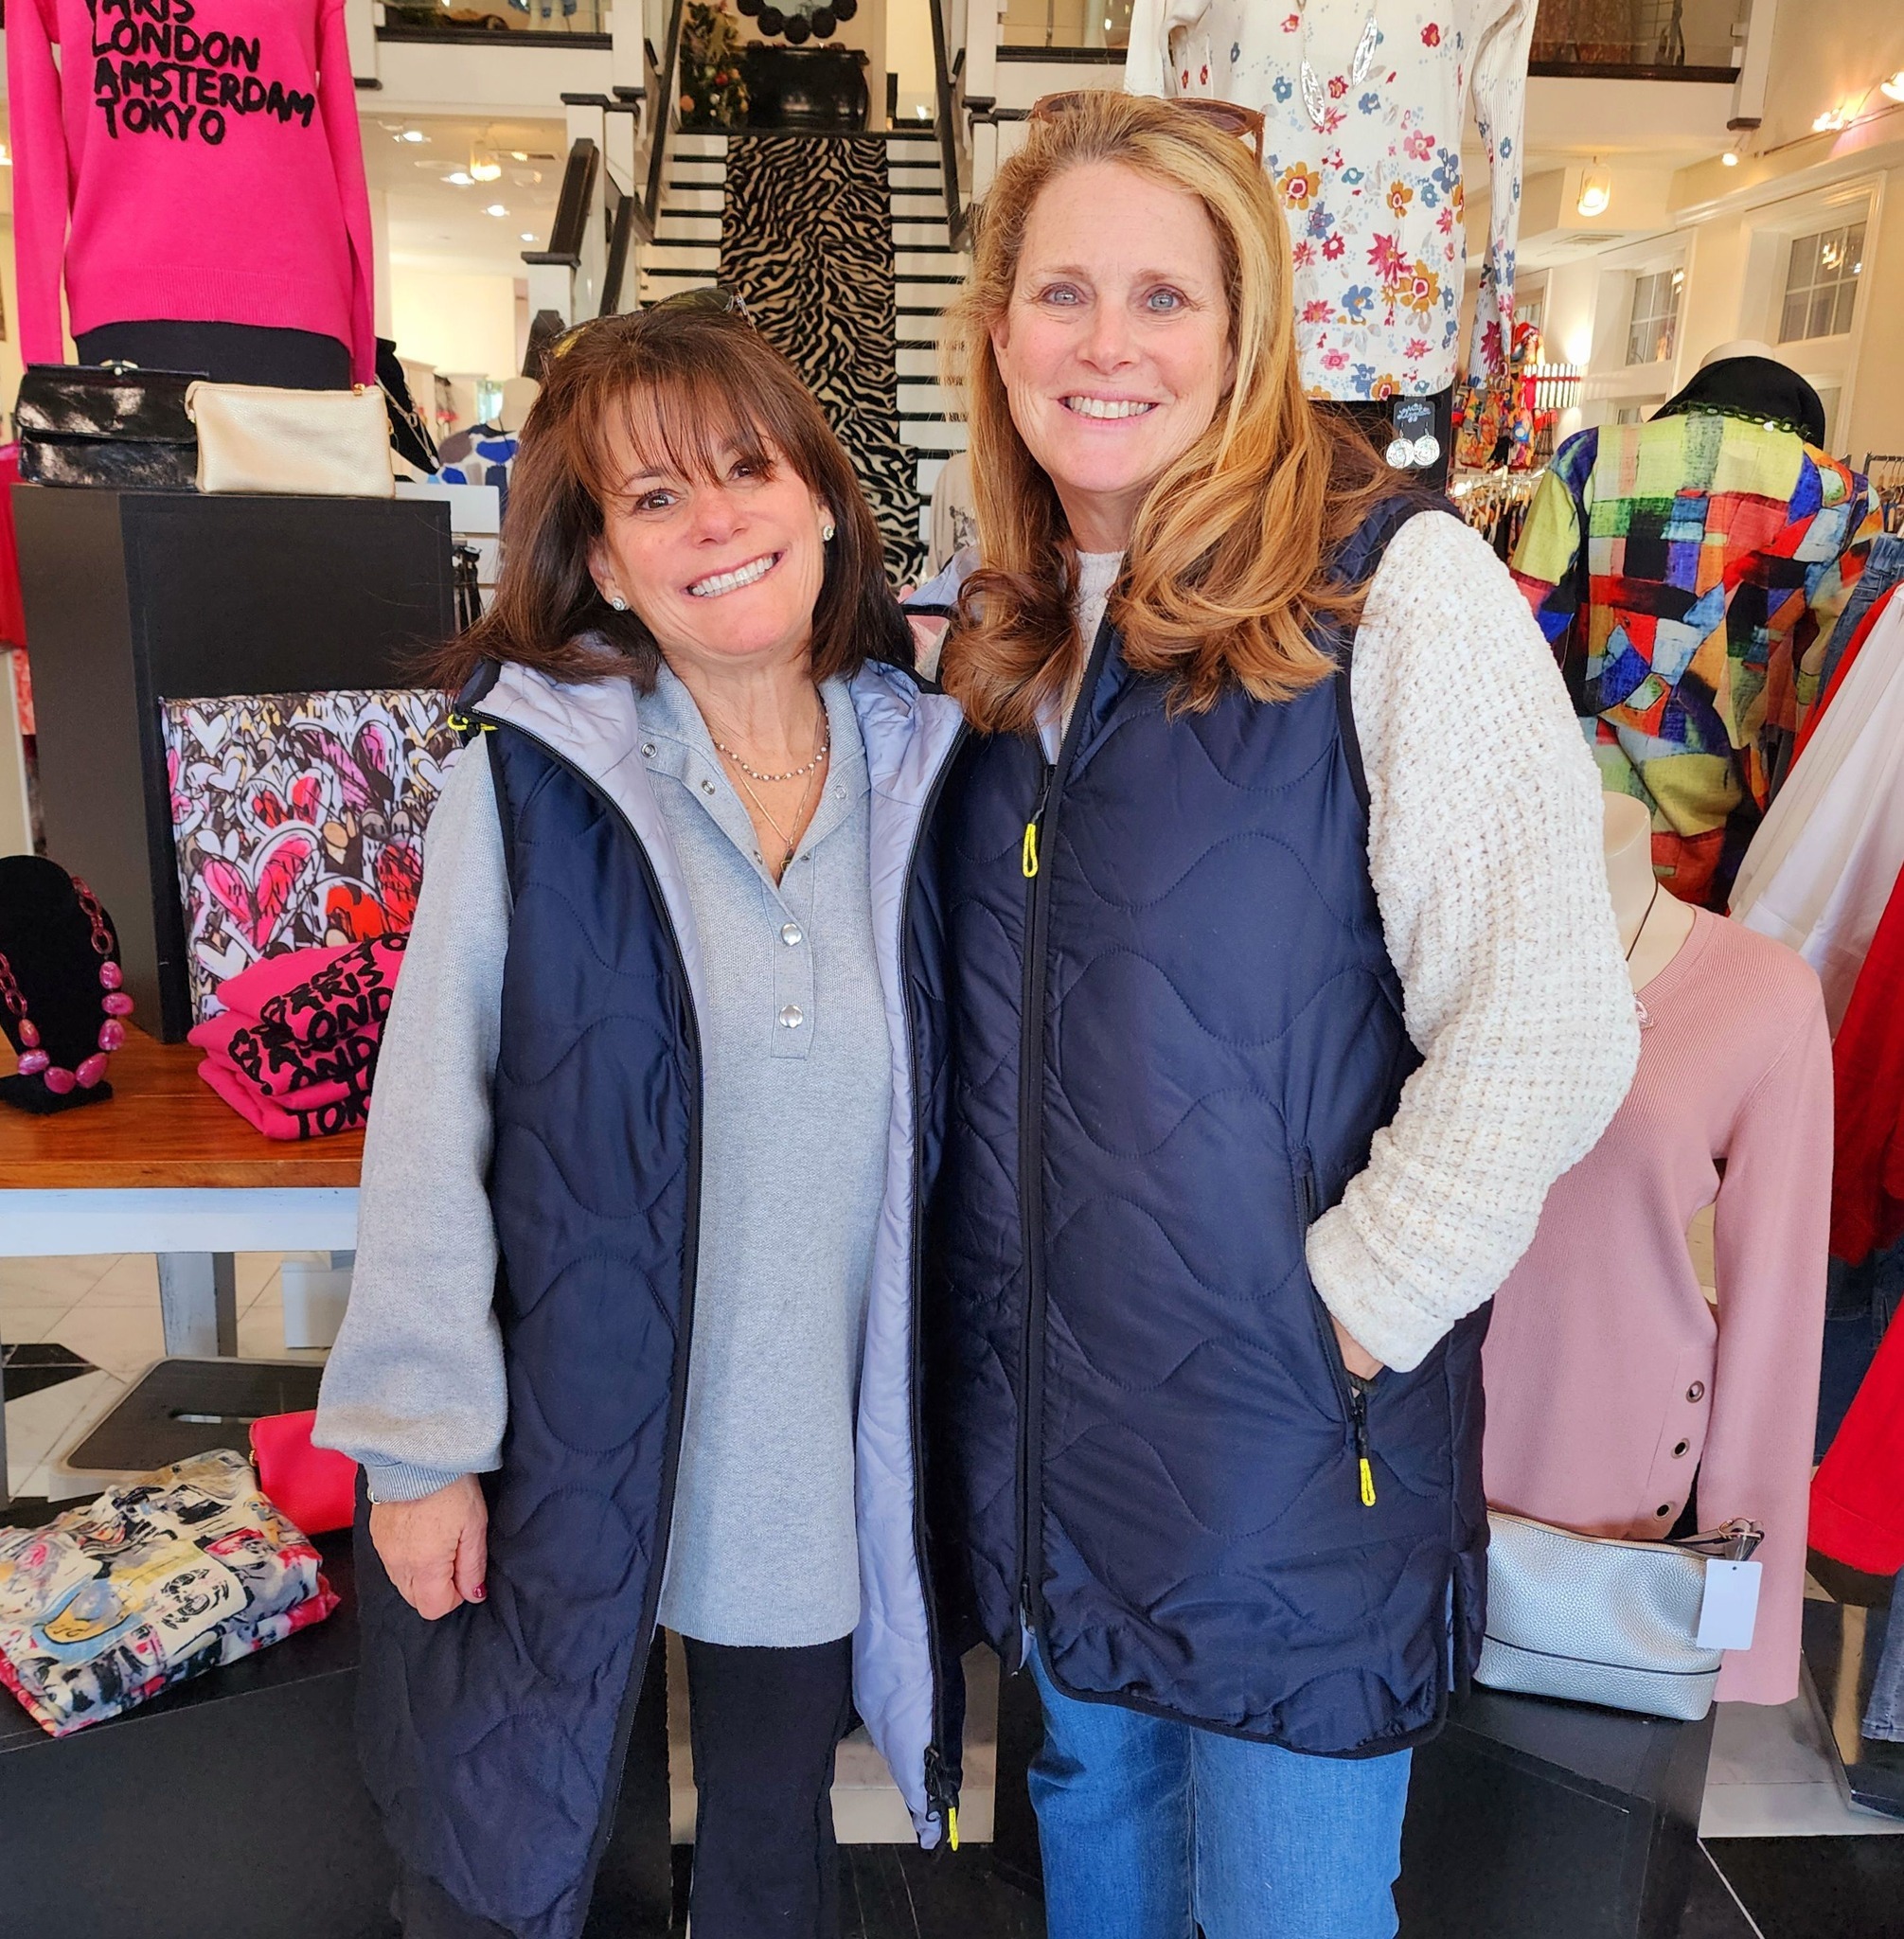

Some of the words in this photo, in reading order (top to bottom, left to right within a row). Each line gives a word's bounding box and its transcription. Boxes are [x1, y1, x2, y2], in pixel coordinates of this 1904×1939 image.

[92, 19, 260, 72] LONDON
[94, 57, 315, 127] AMSTERDAM
[96, 98, 225, 145] TOKYO
